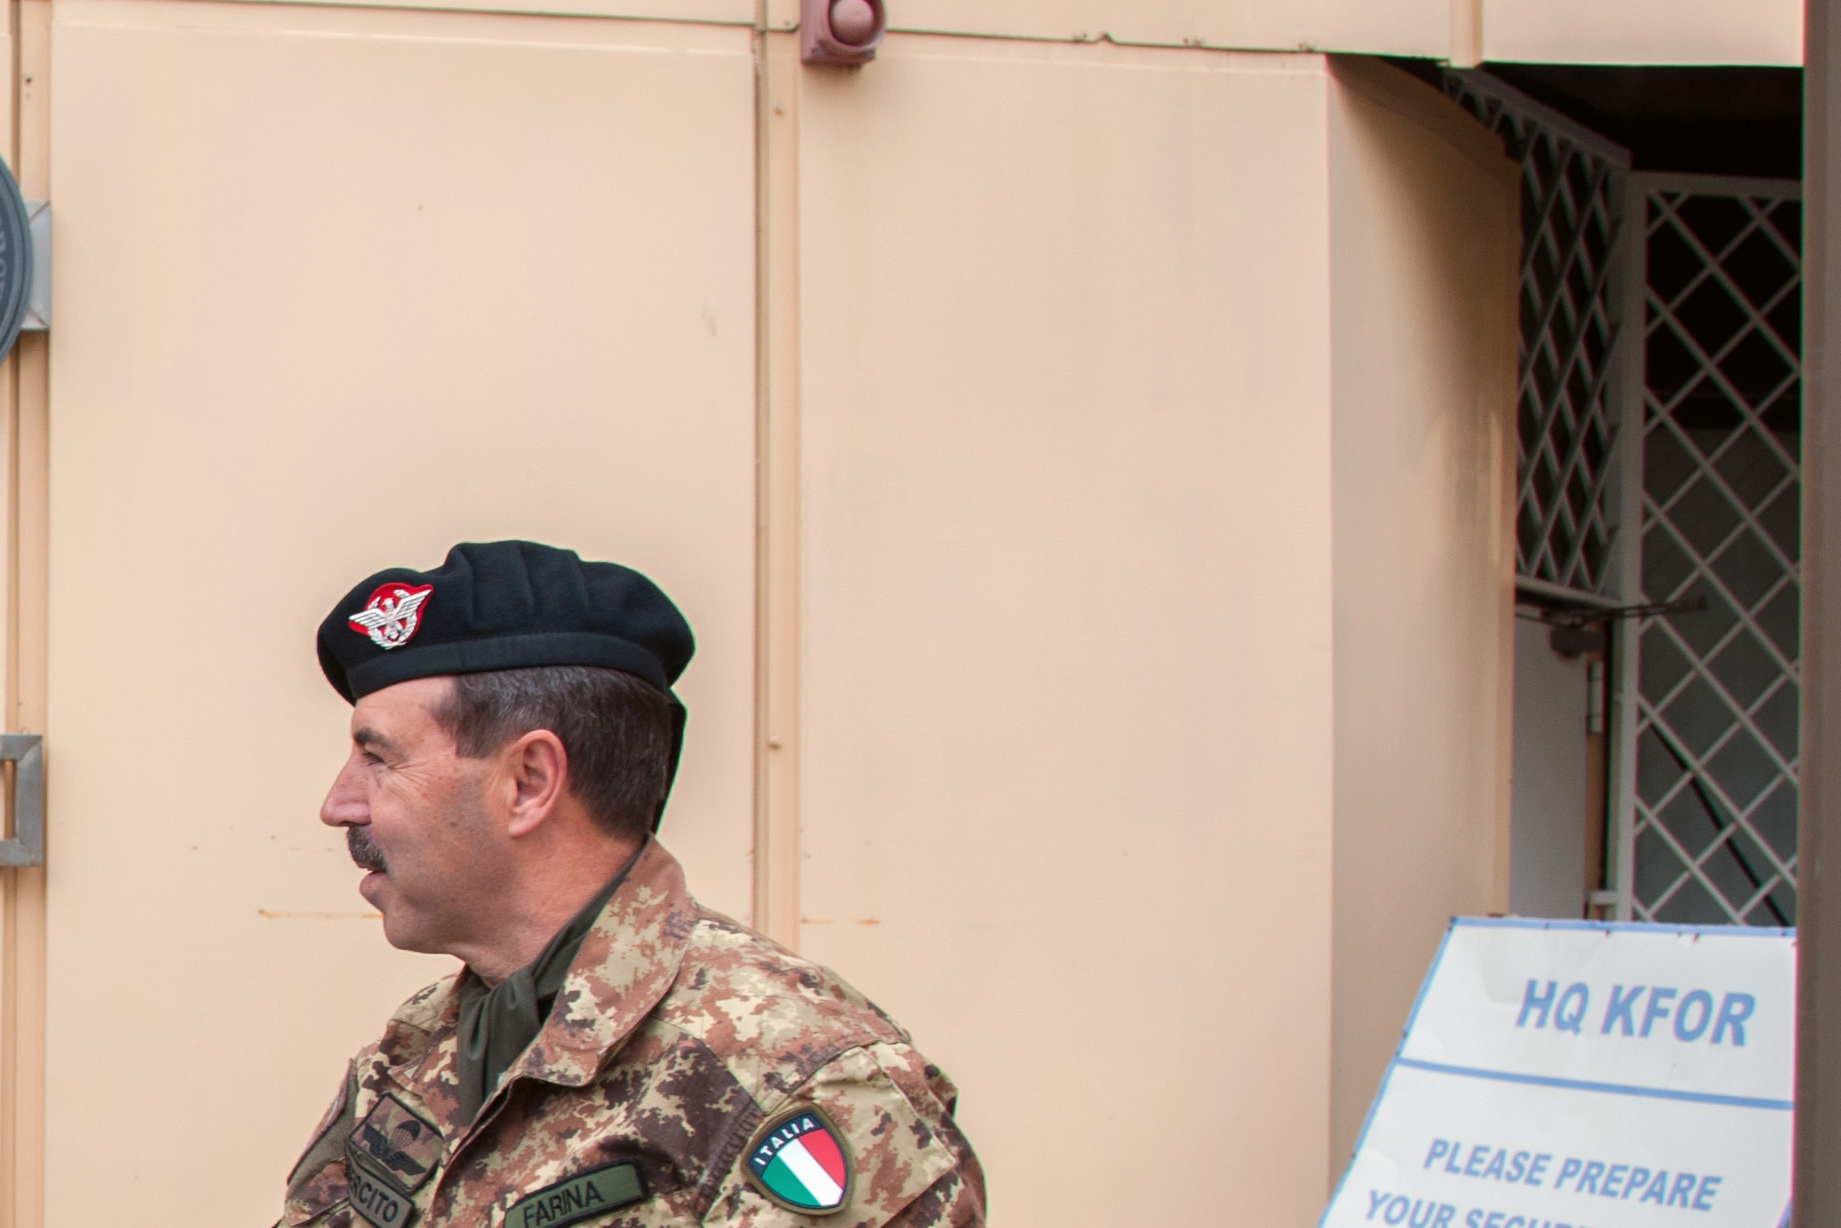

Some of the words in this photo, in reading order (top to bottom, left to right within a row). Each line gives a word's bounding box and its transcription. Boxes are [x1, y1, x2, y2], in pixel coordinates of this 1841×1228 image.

[1516, 978, 1592, 1037] HQ
[1601, 983, 1758, 1048] KFOR
[753, 1117, 815, 1166] ITALIA
[1424, 1137, 1554, 1188] PLEASE
[1554, 1157, 1724, 1213] PREPARE
